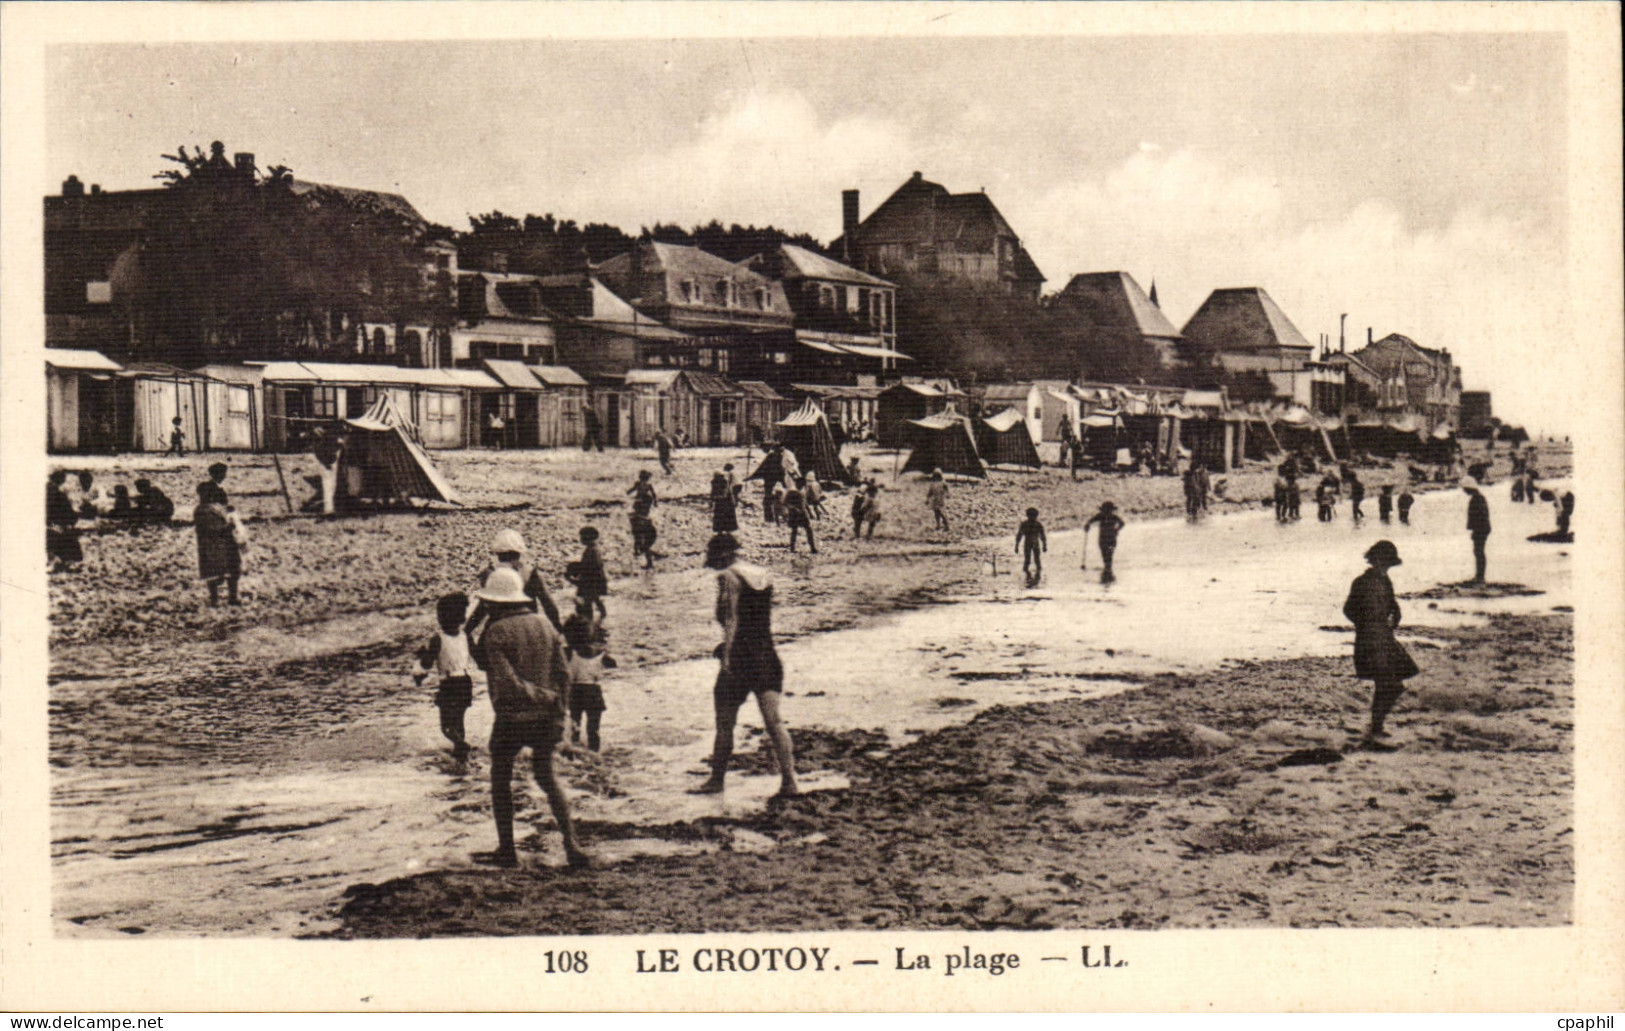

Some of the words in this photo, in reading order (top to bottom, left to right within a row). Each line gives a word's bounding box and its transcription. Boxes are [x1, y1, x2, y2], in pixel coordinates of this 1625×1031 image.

[543, 950, 589, 974] 108
[636, 949, 680, 973] LE
[693, 947, 841, 972] CROTOY.
[895, 947, 931, 970] La
[945, 945, 1020, 976] plage
